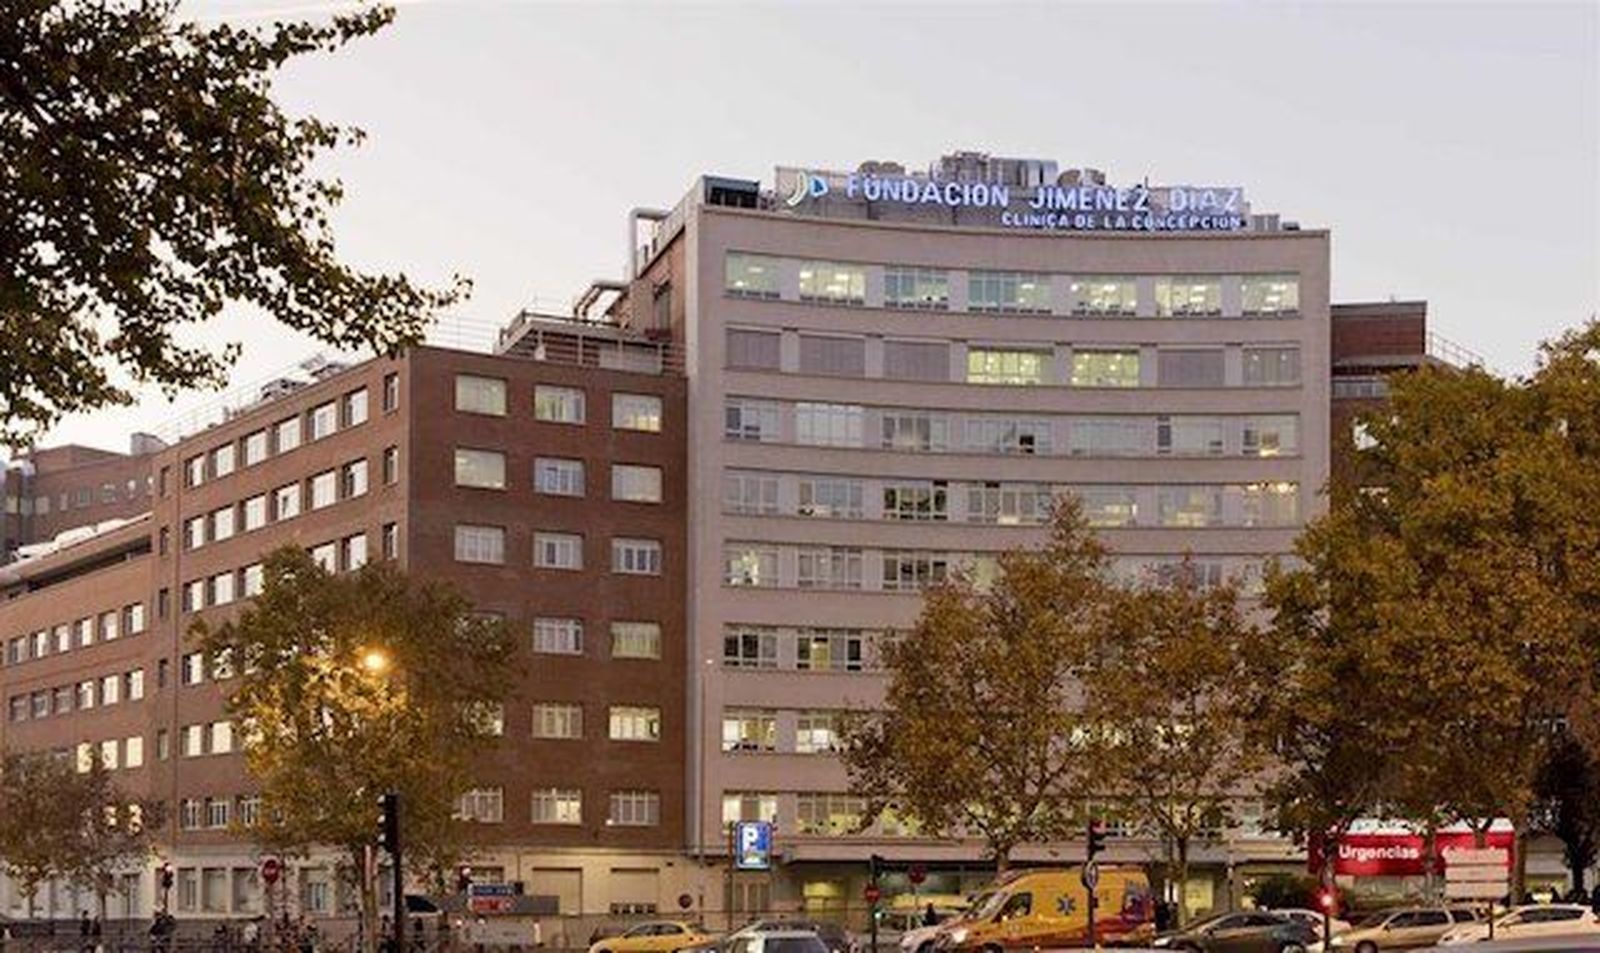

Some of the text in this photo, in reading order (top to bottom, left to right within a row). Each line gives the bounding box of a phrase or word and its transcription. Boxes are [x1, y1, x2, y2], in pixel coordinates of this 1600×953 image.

[847, 174, 1239, 212] FUNDACION JIMENEZ DIAZ
[1002, 212, 1240, 229] CLINICA DE LA CONCEPCION
[742, 826, 759, 851] P
[1338, 845, 1420, 861] Urgencias
